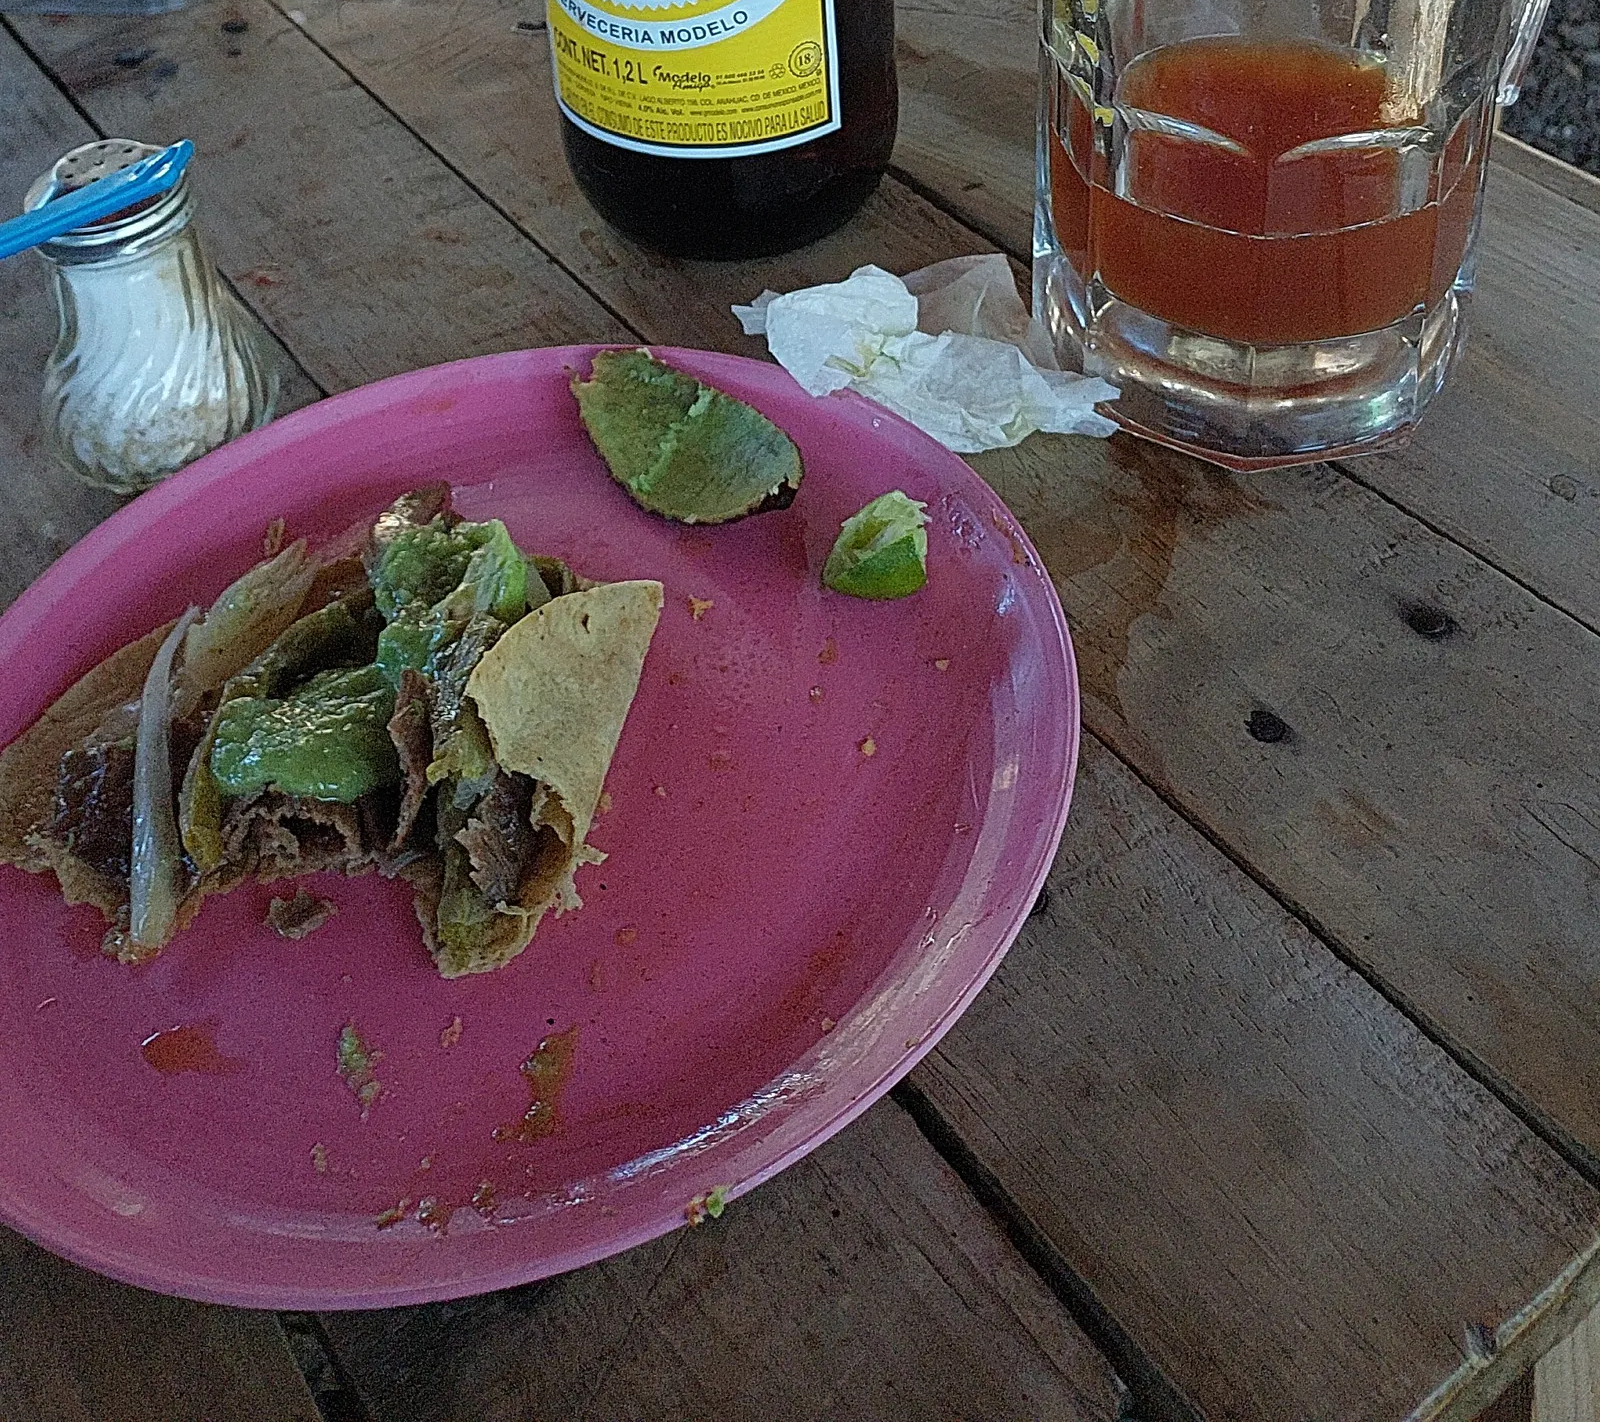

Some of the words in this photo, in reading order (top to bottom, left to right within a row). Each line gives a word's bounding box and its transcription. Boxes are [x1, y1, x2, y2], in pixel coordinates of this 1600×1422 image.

[659, 10, 748, 45] MODELO
[582, 45, 610, 76] NET.
[612, 58, 635, 84] 1,2
[637, 61, 649, 85] L
[653, 65, 711, 83] Modelo
[645, 119, 665, 139] ESTE
[667, 122, 714, 141] PRODUCTO
[716, 122, 729, 140] ES
[729, 117, 763, 139] NOCIVO
[764, 112, 788, 135] PARA
[787, 109, 800, 129] LA
[800, 100, 826, 127] SALUD
